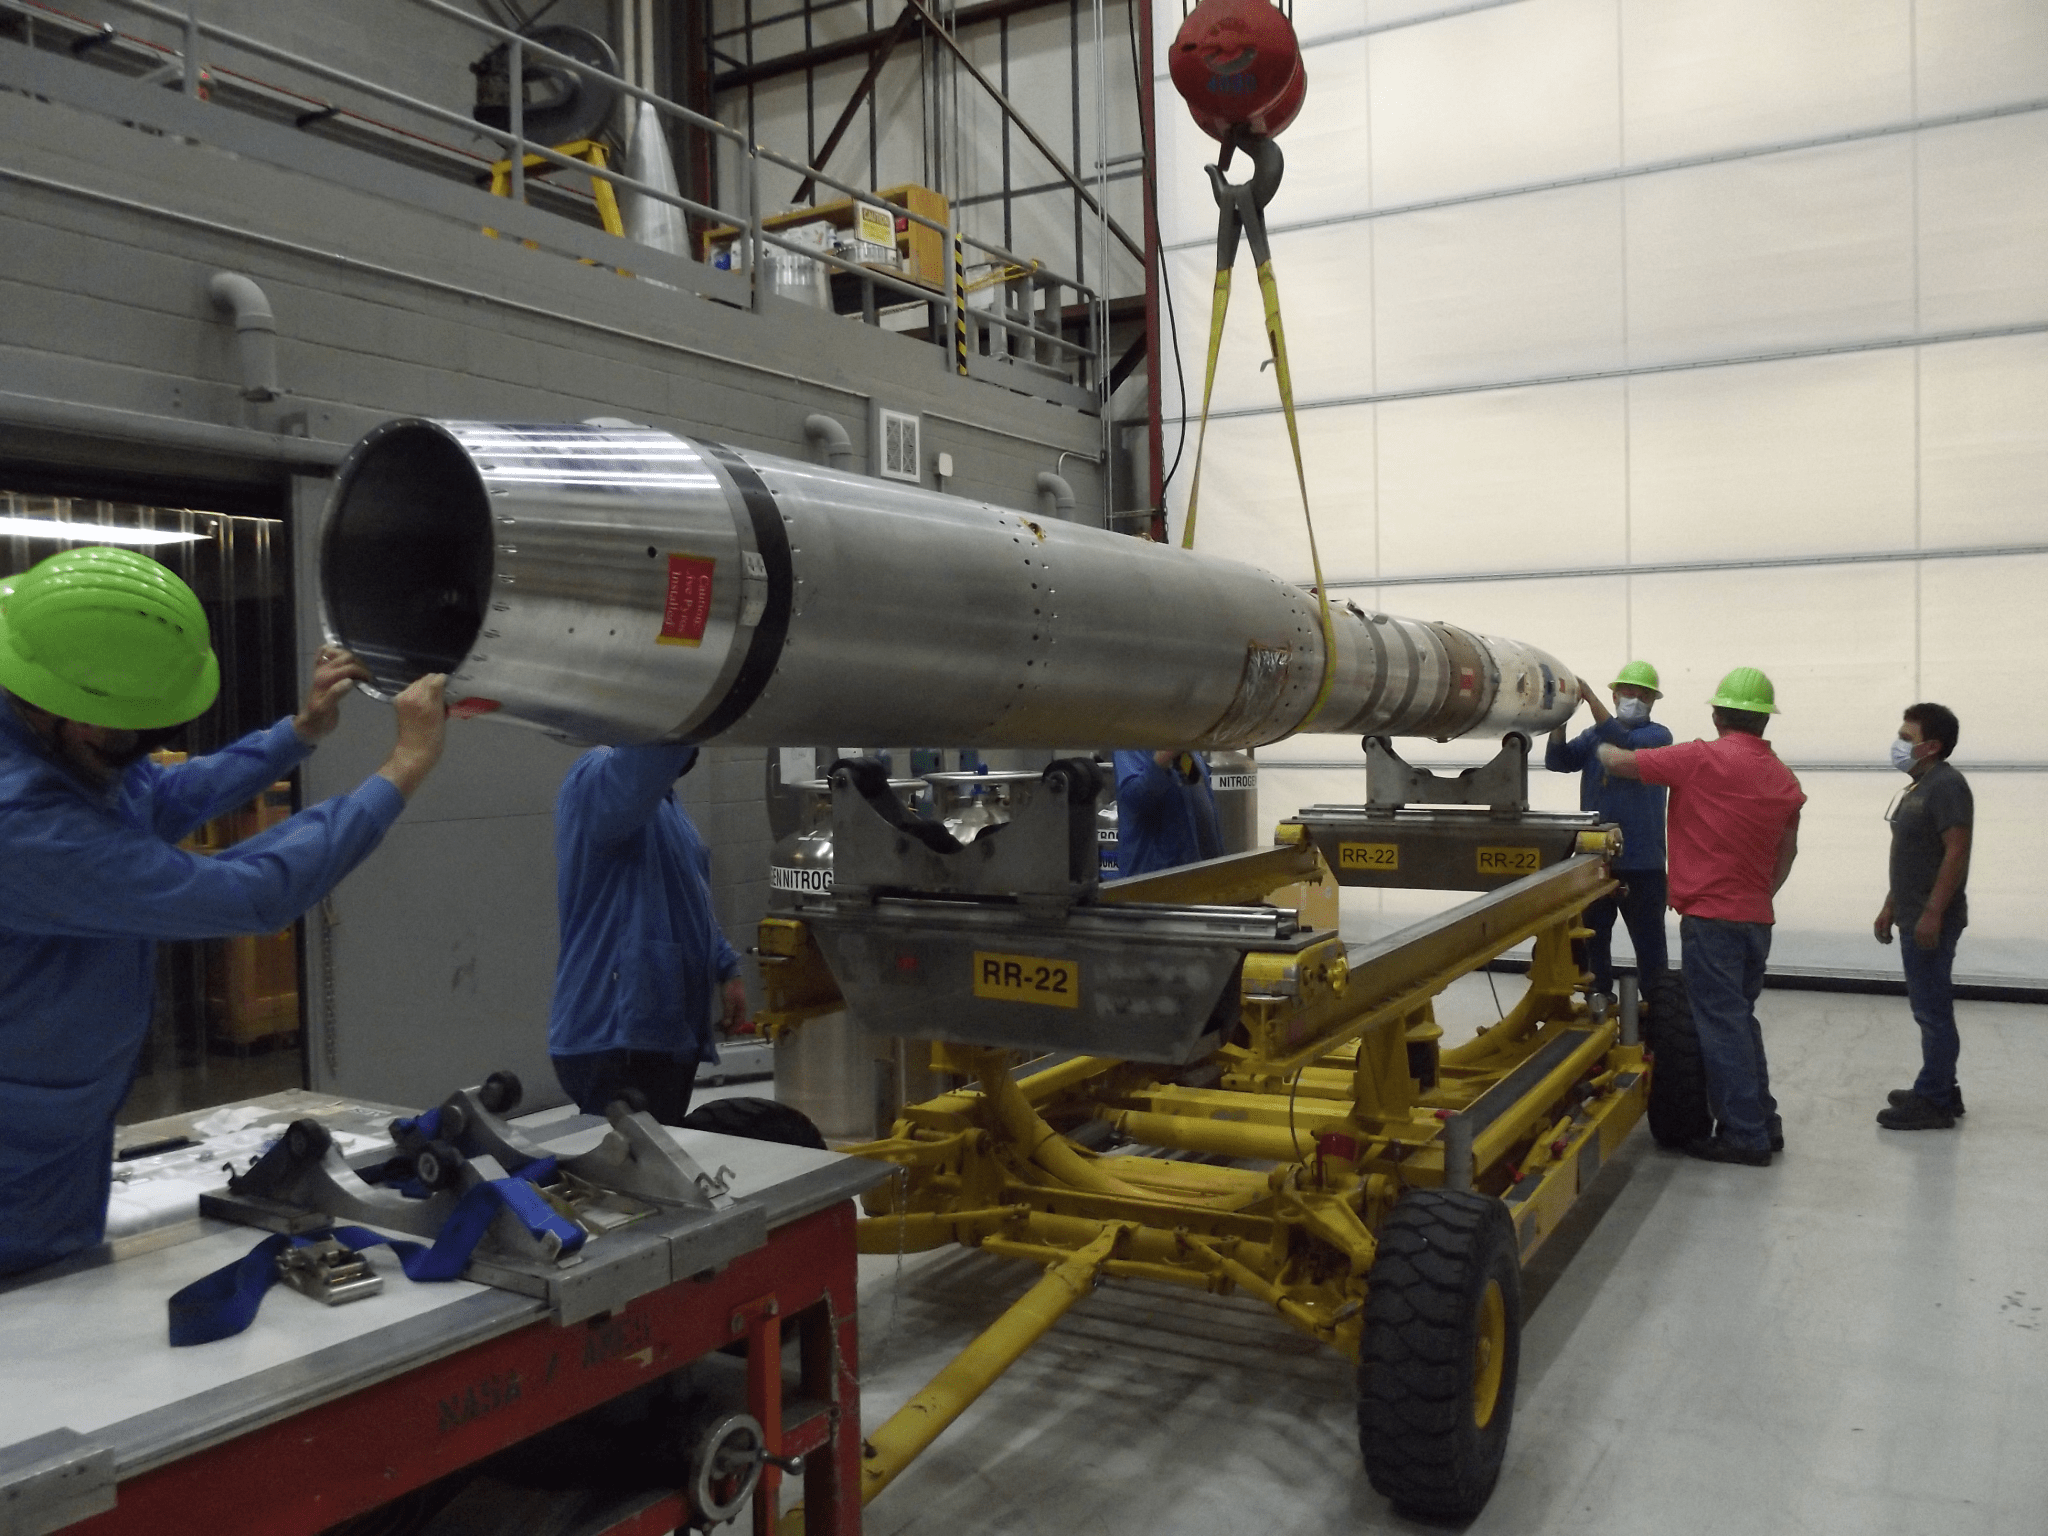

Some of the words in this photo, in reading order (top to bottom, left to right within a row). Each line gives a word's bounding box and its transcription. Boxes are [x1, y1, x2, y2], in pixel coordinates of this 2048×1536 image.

[665, 571, 682, 626] Installed
[1342, 848, 1395, 865] RR-22
[1480, 852, 1536, 869] RR-22
[983, 959, 1068, 993] RR-22
[438, 1368, 522, 1433] NASA
